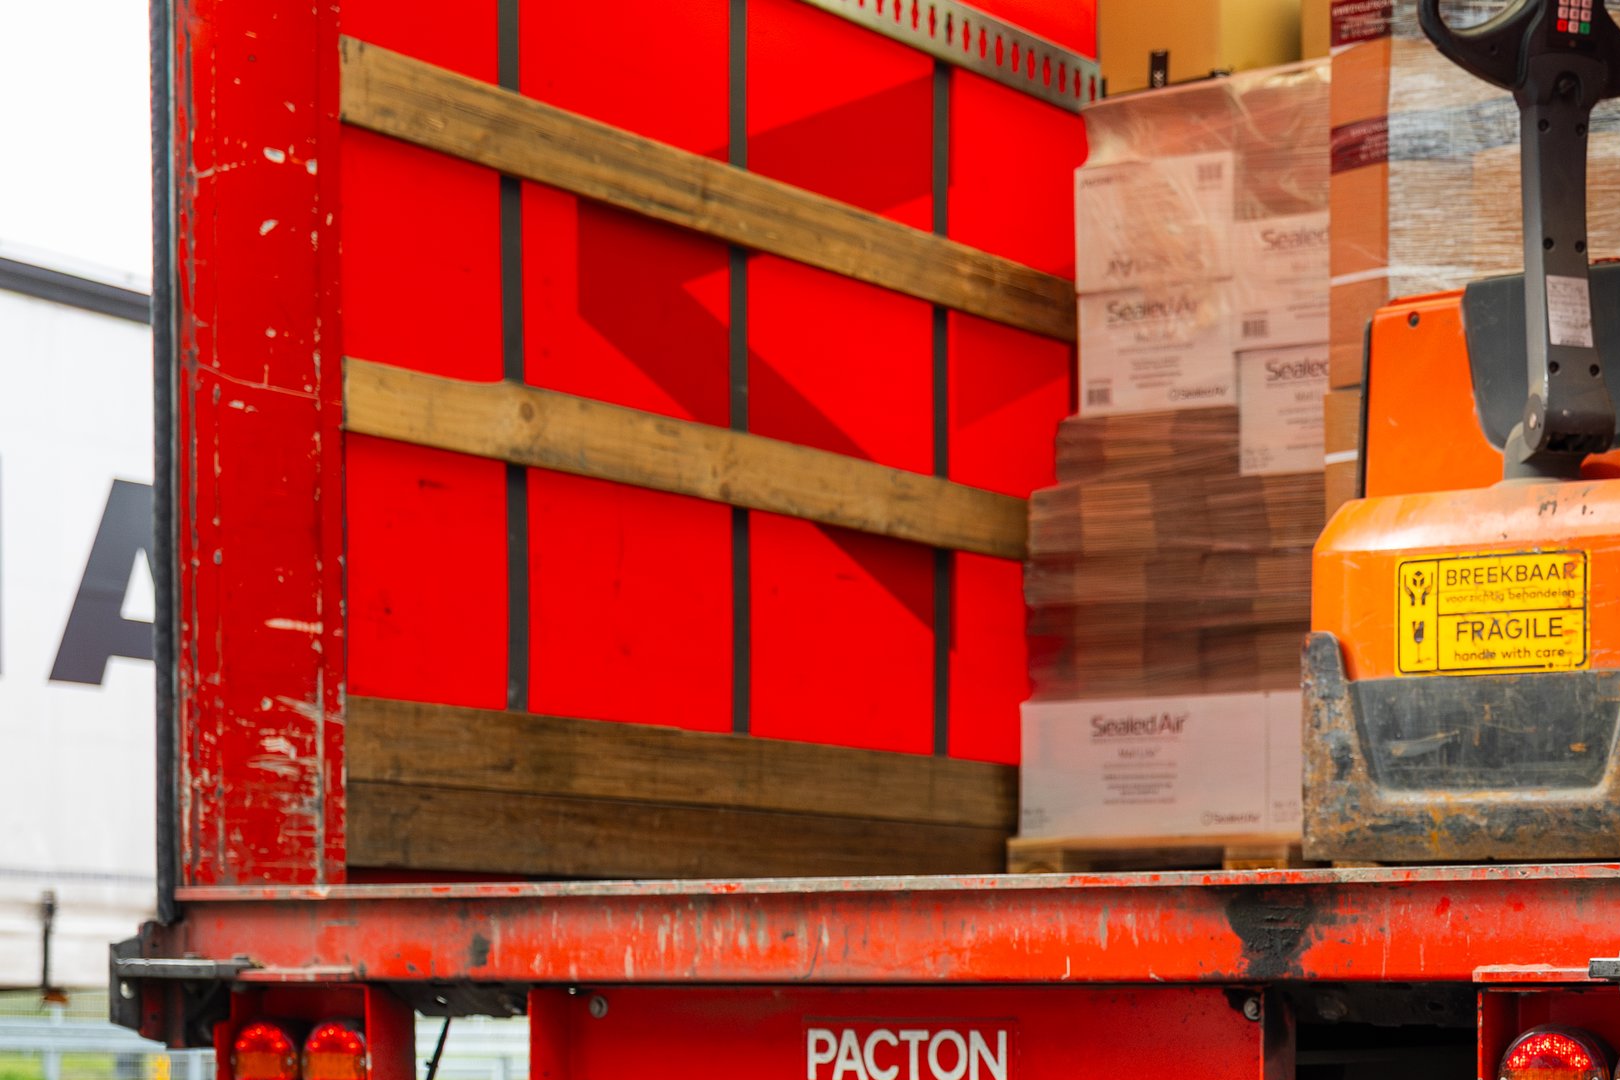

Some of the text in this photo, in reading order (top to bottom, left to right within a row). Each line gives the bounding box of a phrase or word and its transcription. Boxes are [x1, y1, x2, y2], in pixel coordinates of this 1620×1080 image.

[1446, 562, 1577, 586] BREEKBAAR
[1445, 586, 1575, 604] voorzichtig behandelen
[1456, 616, 1563, 642] FRAGILE
[1454, 648, 1566, 662] handle with care
[1090, 713, 1157, 738] Sealed
